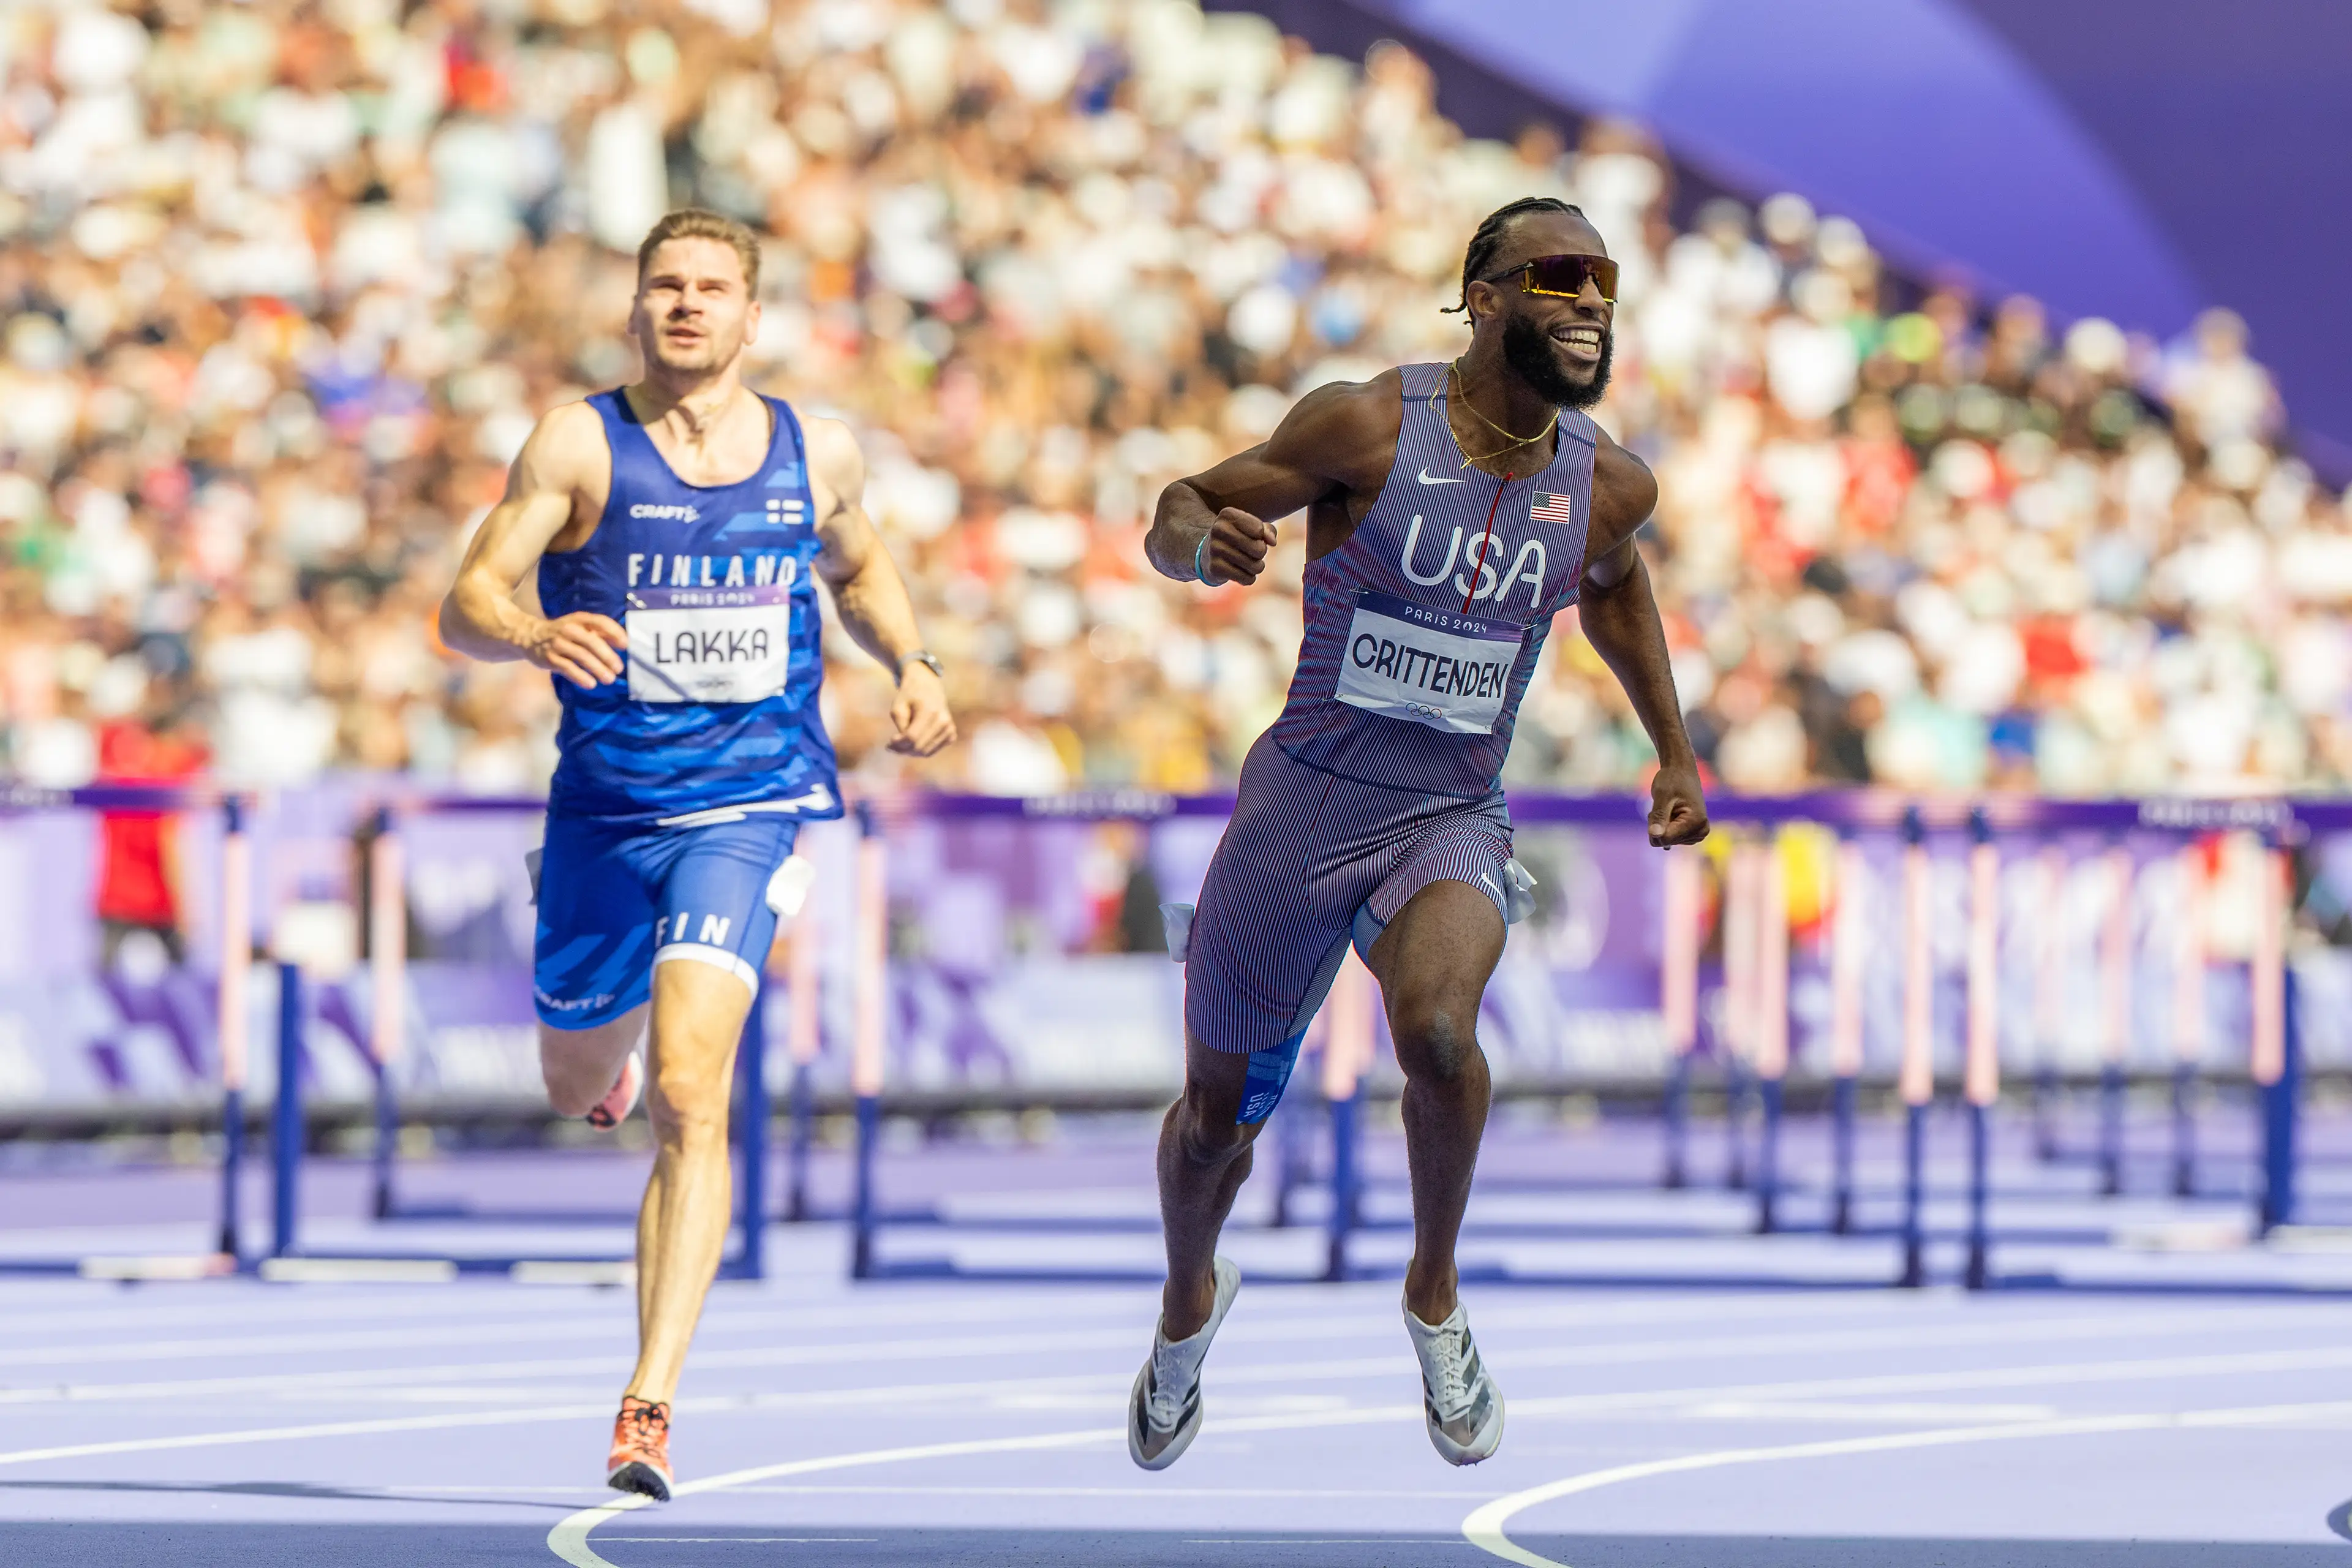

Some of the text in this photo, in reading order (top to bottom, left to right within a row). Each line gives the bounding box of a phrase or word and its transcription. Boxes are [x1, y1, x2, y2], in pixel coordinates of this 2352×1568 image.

[629, 503, 684, 521] CRAFT
[627, 553, 796, 587] FINLAND
[1401, 514, 1547, 608] USA
[1452, 619, 1487, 633] 2024
[655, 628, 769, 664] LAKKA
[1352, 633, 1509, 698] CRITTENDEN
[655, 911, 731, 948] FIN
[1243, 1092, 1264, 1117] USA
